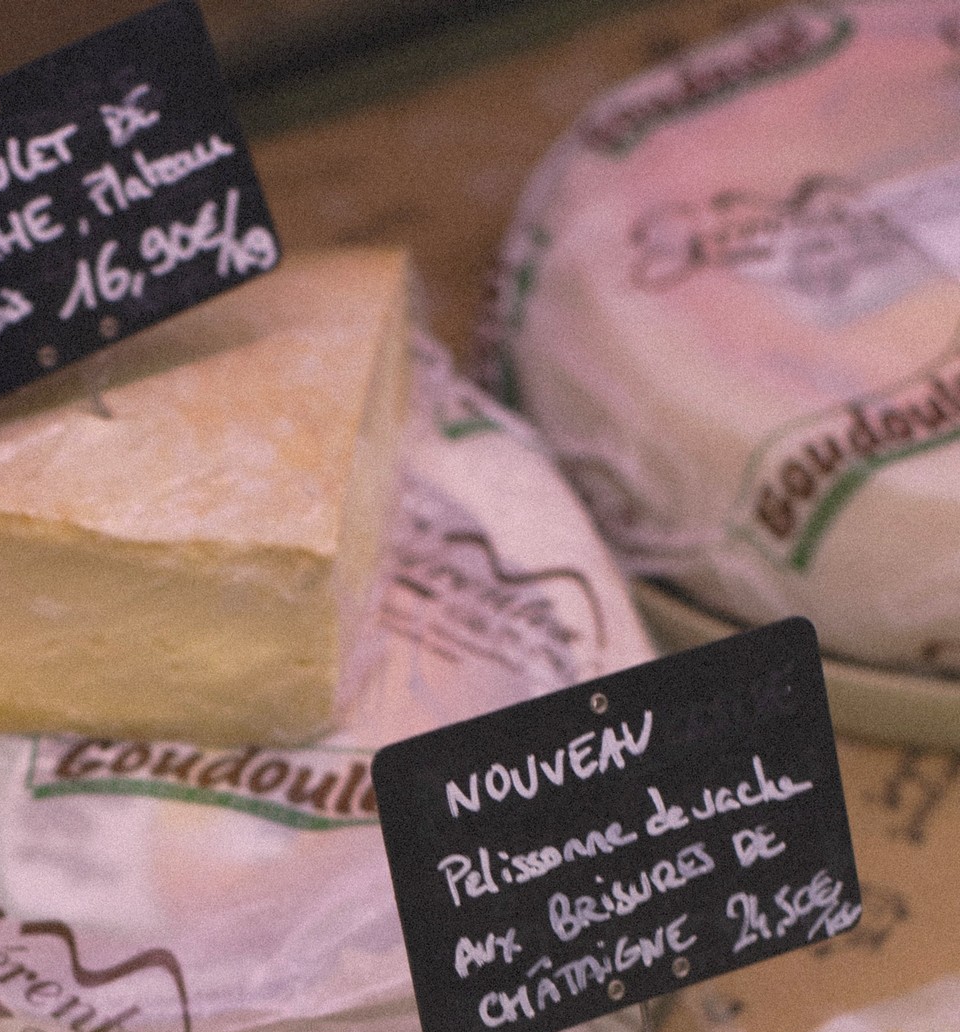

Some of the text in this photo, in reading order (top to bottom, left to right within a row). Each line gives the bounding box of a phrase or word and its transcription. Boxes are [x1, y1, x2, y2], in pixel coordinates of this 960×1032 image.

[100, 84, 159, 147] DE
[755, 371, 960, 540] Goudoul
[445, 711, 652, 817] NOUVEAU
[733, 826, 785, 867] DE
